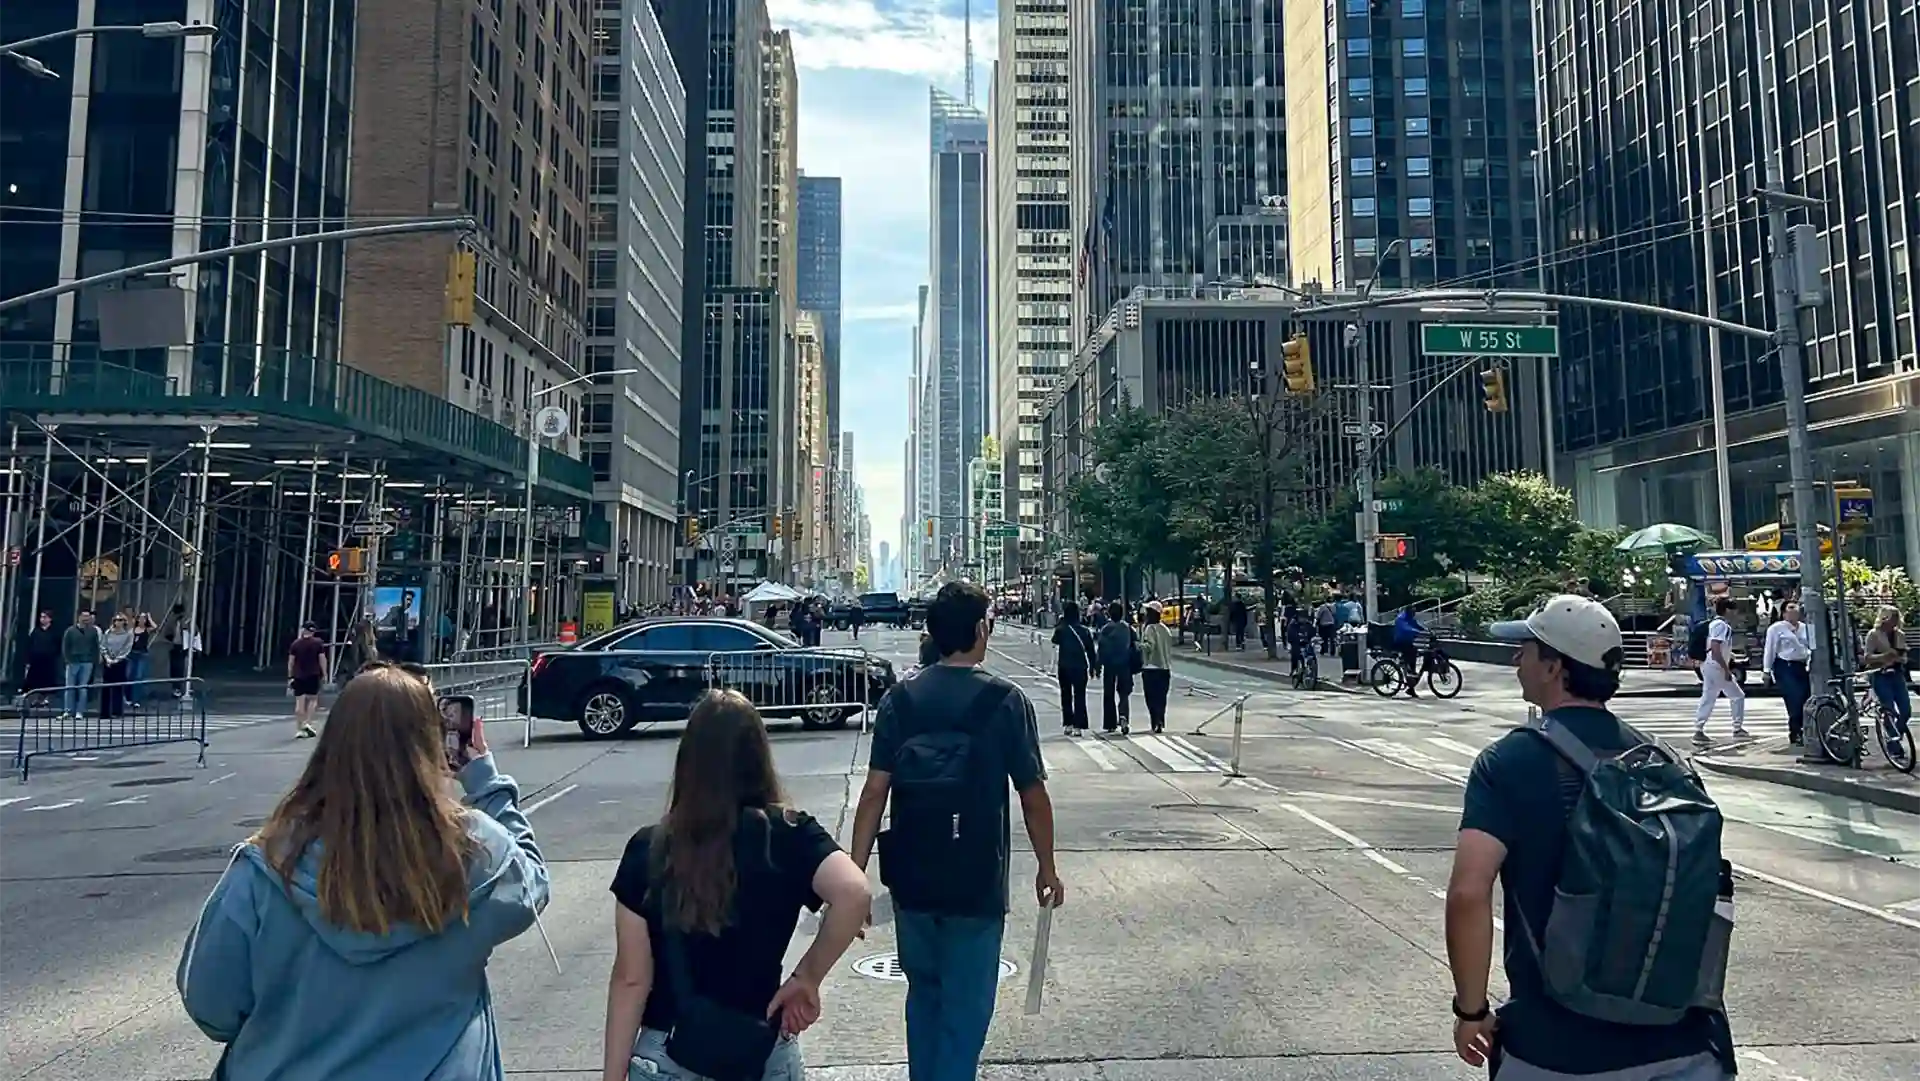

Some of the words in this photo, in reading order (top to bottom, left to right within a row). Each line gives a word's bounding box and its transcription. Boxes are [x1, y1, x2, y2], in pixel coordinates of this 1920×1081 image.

[1460, 331, 1472, 348] W
[1480, 331, 1499, 349] 55
[1506, 331, 1523, 349] St
